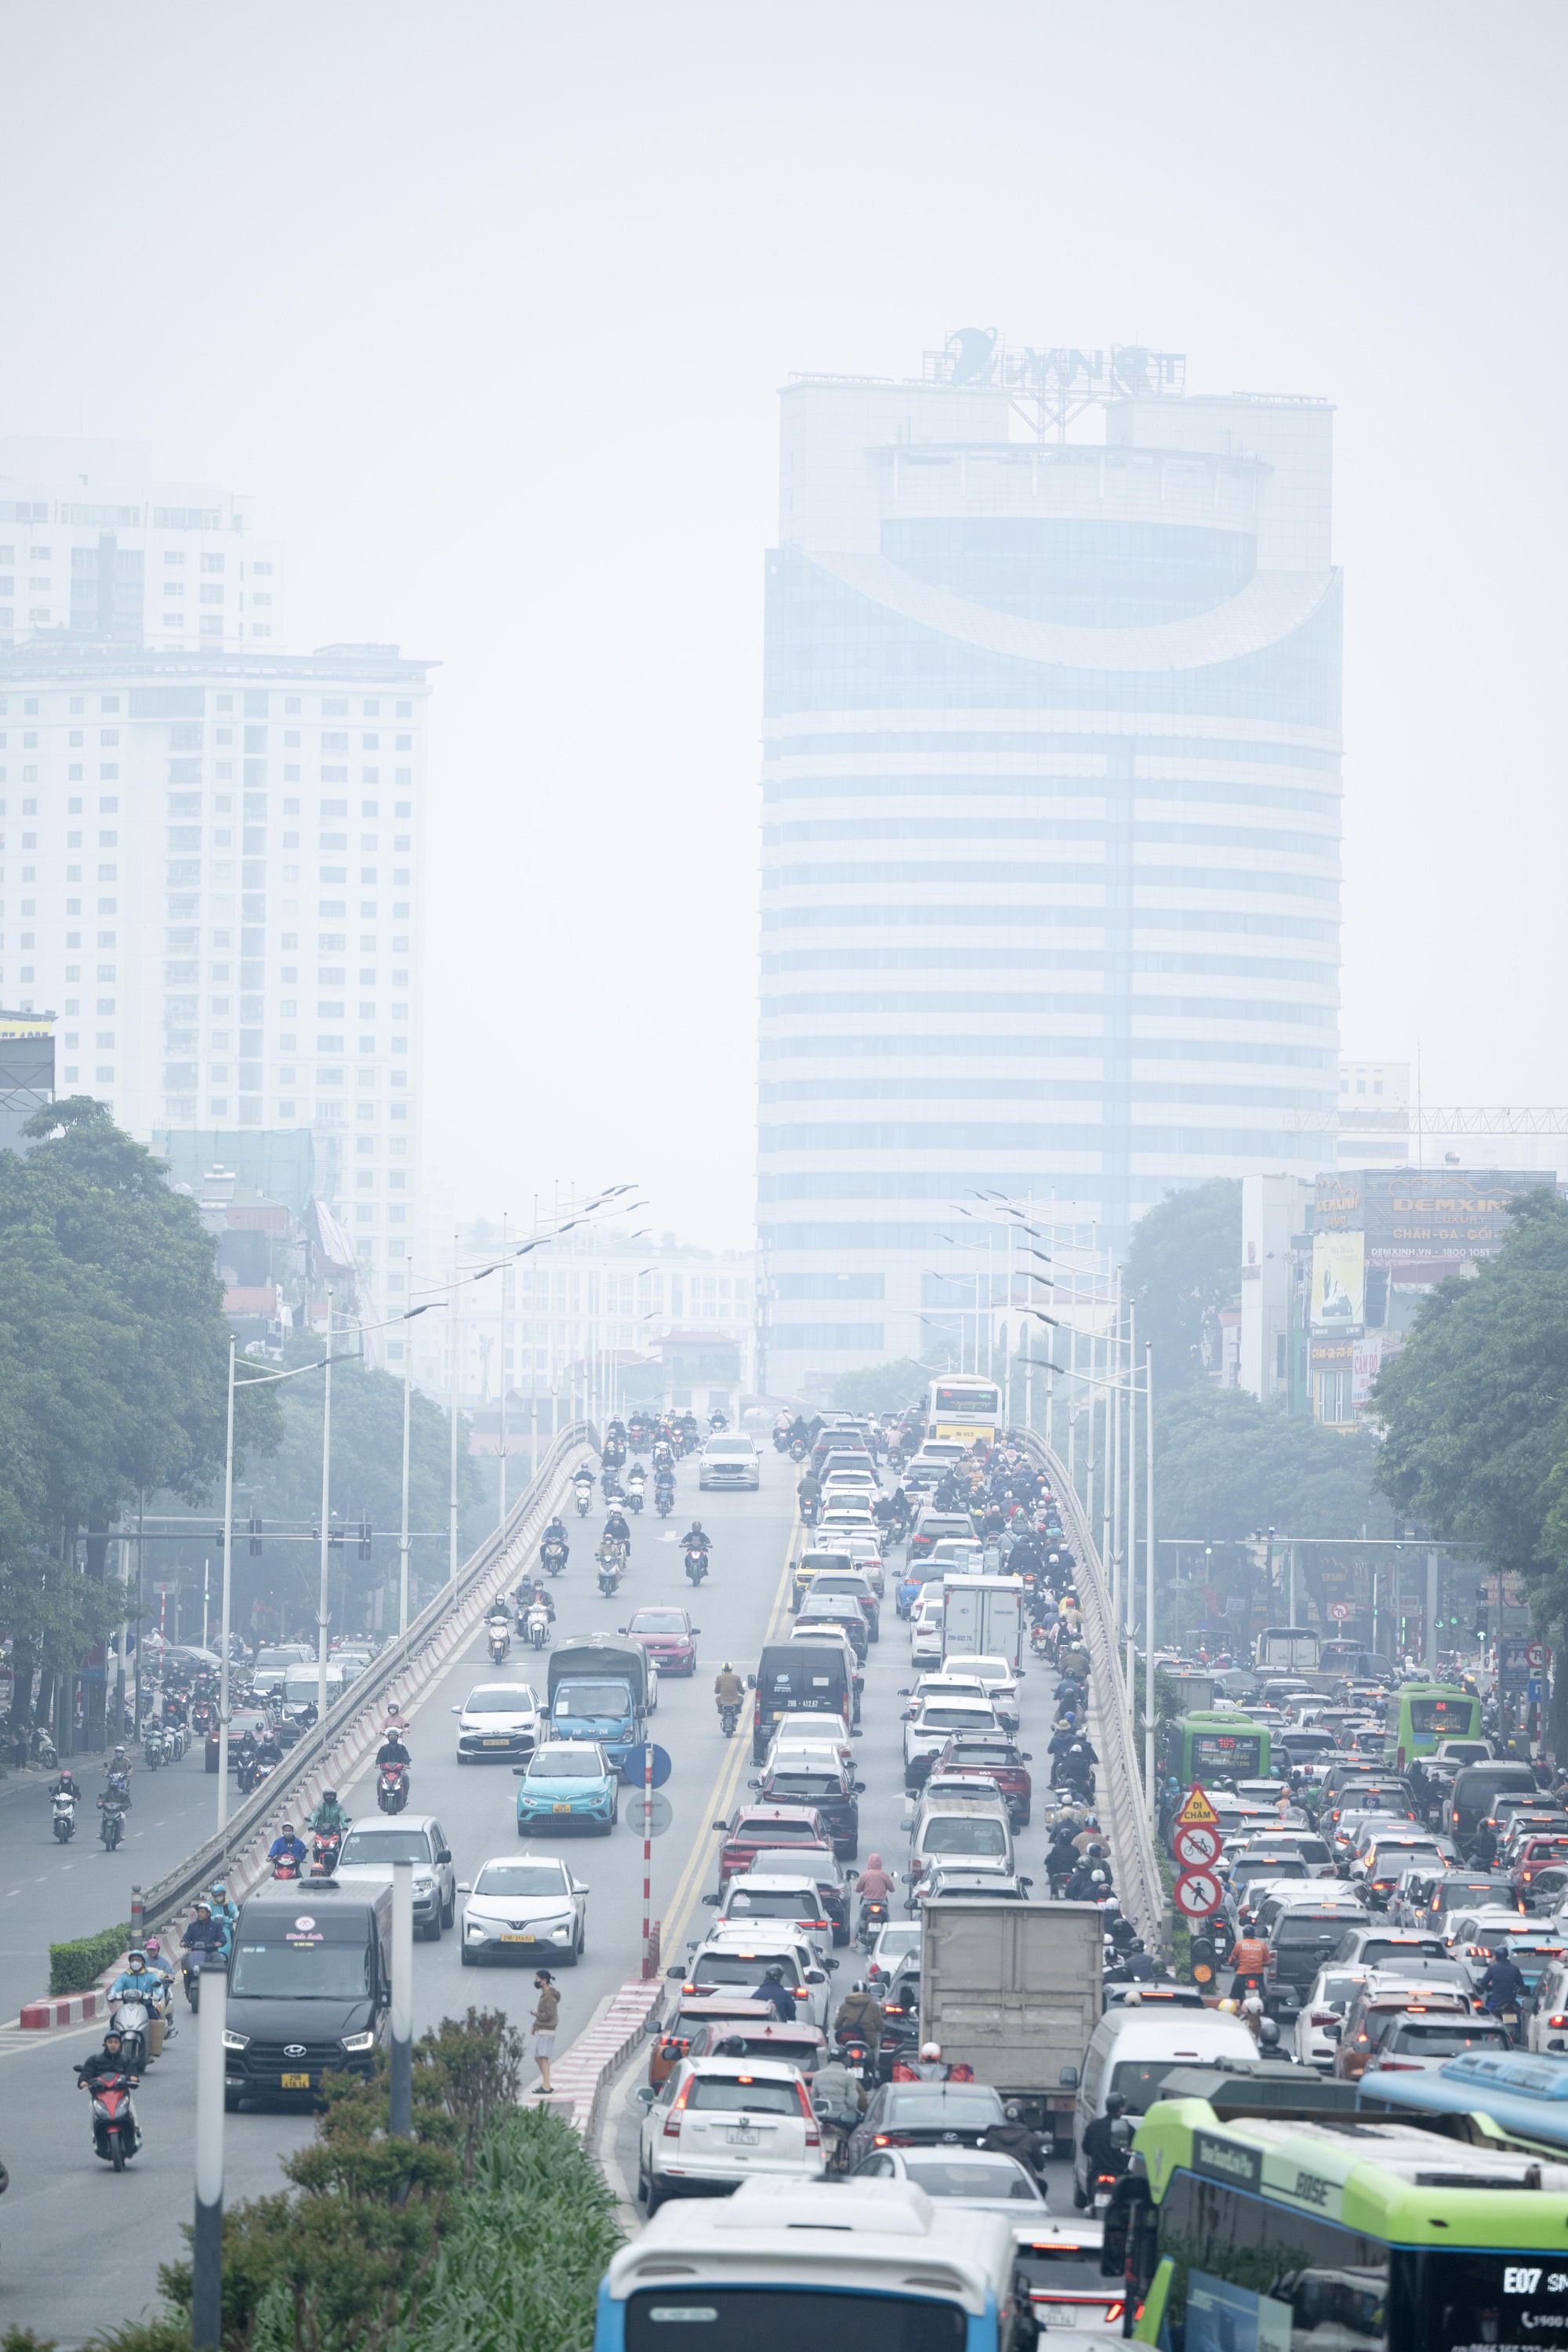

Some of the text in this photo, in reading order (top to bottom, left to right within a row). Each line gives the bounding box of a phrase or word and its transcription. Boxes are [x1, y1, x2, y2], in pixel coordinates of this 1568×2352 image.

[1316, 1196, 1358, 1212] DEMXINH
[1393, 1198, 1508, 1212] DEMXIN
[1392, 1225, 1493, 1240] CHĂN GA GỐI
[1371, 1248, 1432, 1257] DEMXINH.VN
[1443, 1248, 1466, 1257] 1800
[1184, 1811, 1211, 1820] CHẬM
[1296, 2171, 1330, 2207] BOSE
[1503, 2267, 1543, 2294] E07
